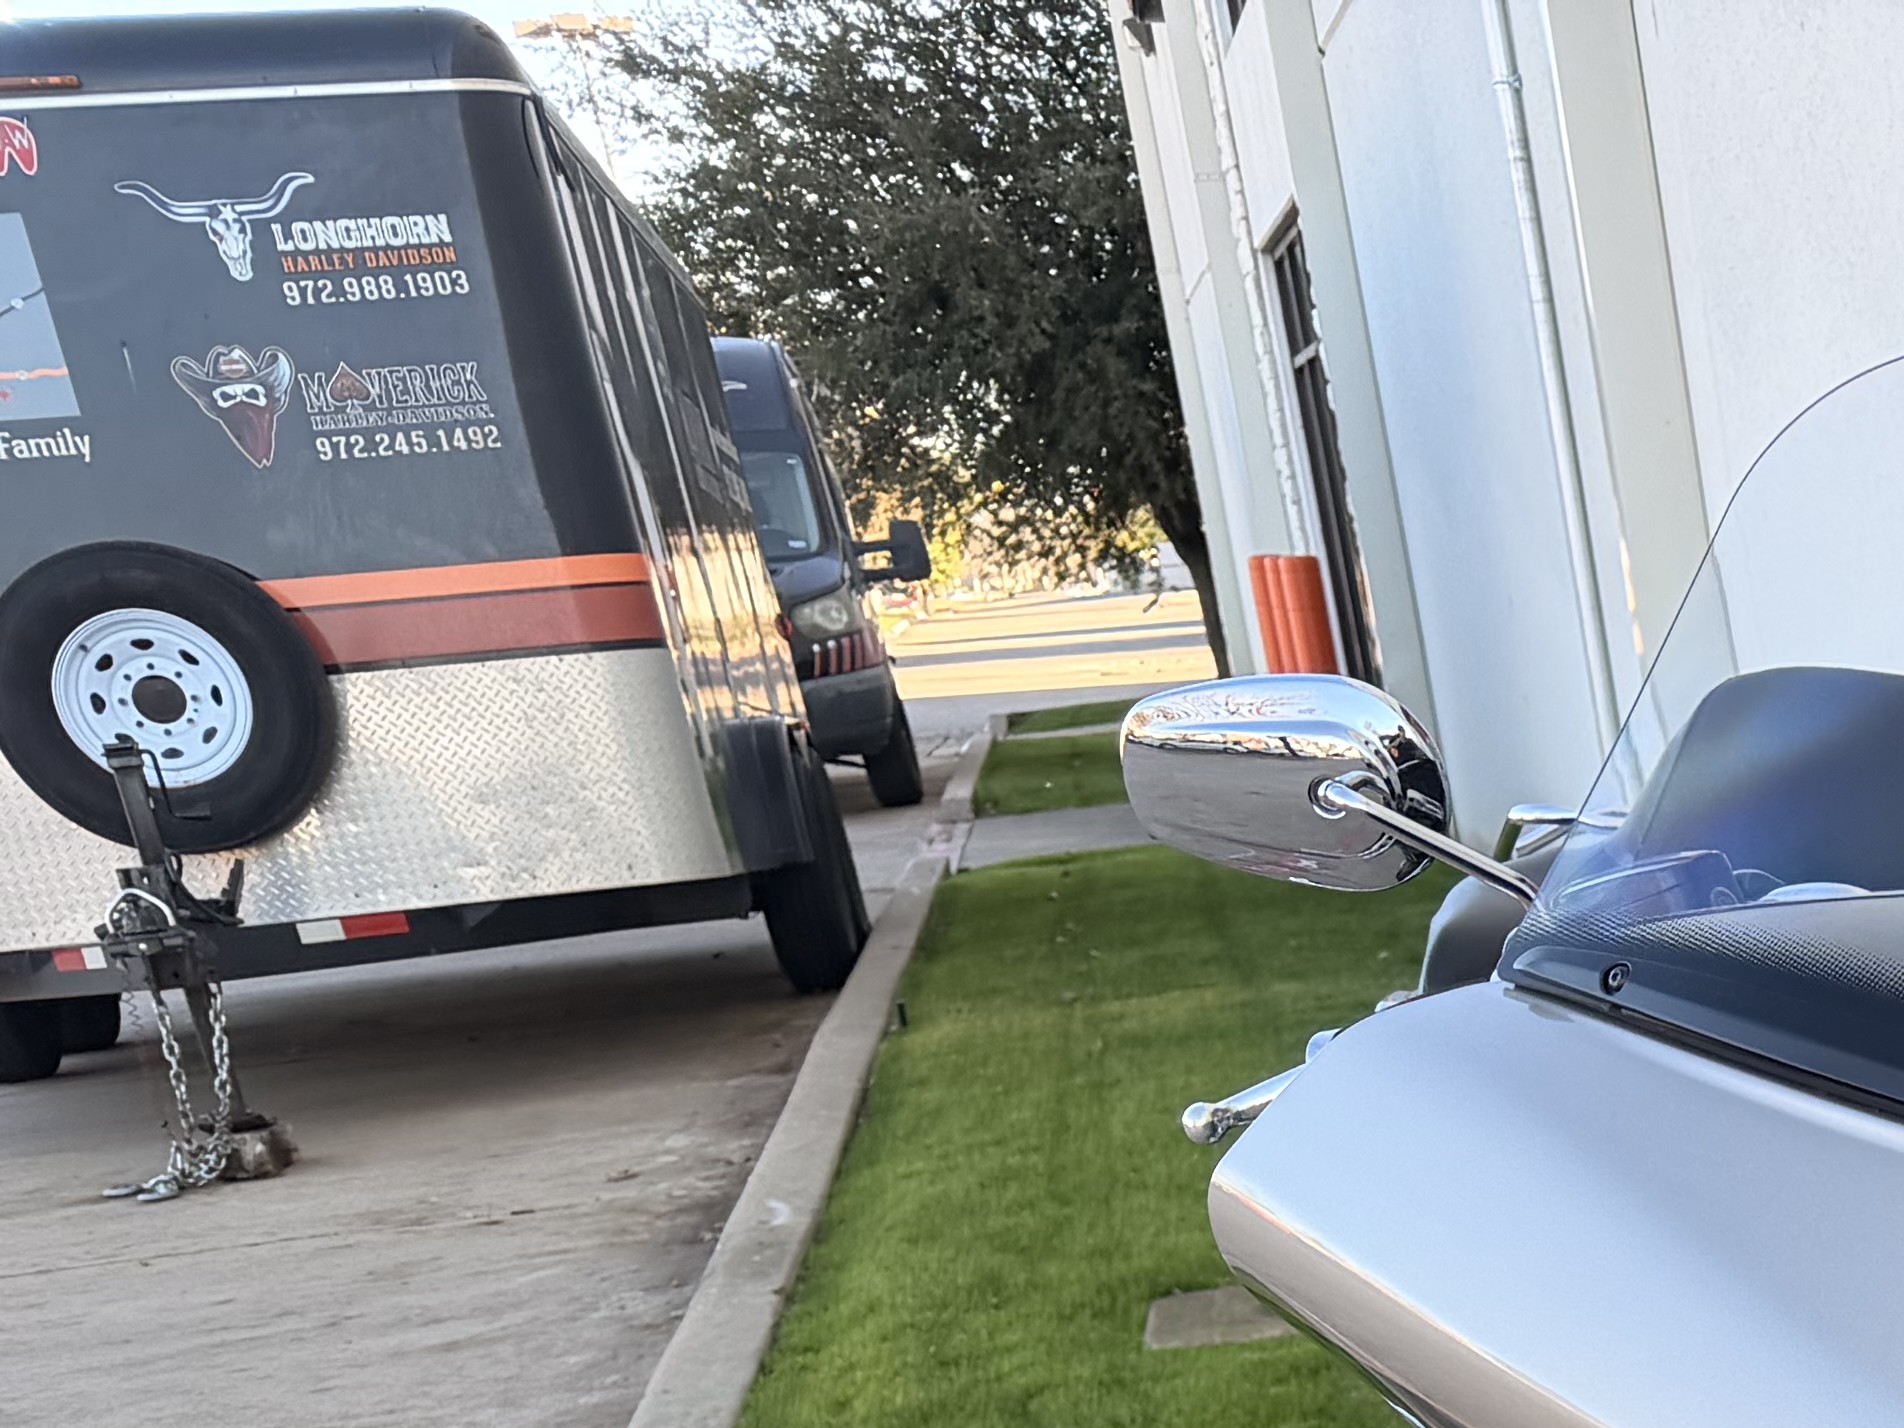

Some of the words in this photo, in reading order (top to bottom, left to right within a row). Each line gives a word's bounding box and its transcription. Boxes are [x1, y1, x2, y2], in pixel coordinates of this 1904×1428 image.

[271, 214, 453, 251] LONGHORN
[282, 270, 470, 306] 972.988.1903
[0, 427, 91, 463] Family
[315, 425, 502, 461] 972.245.1492
